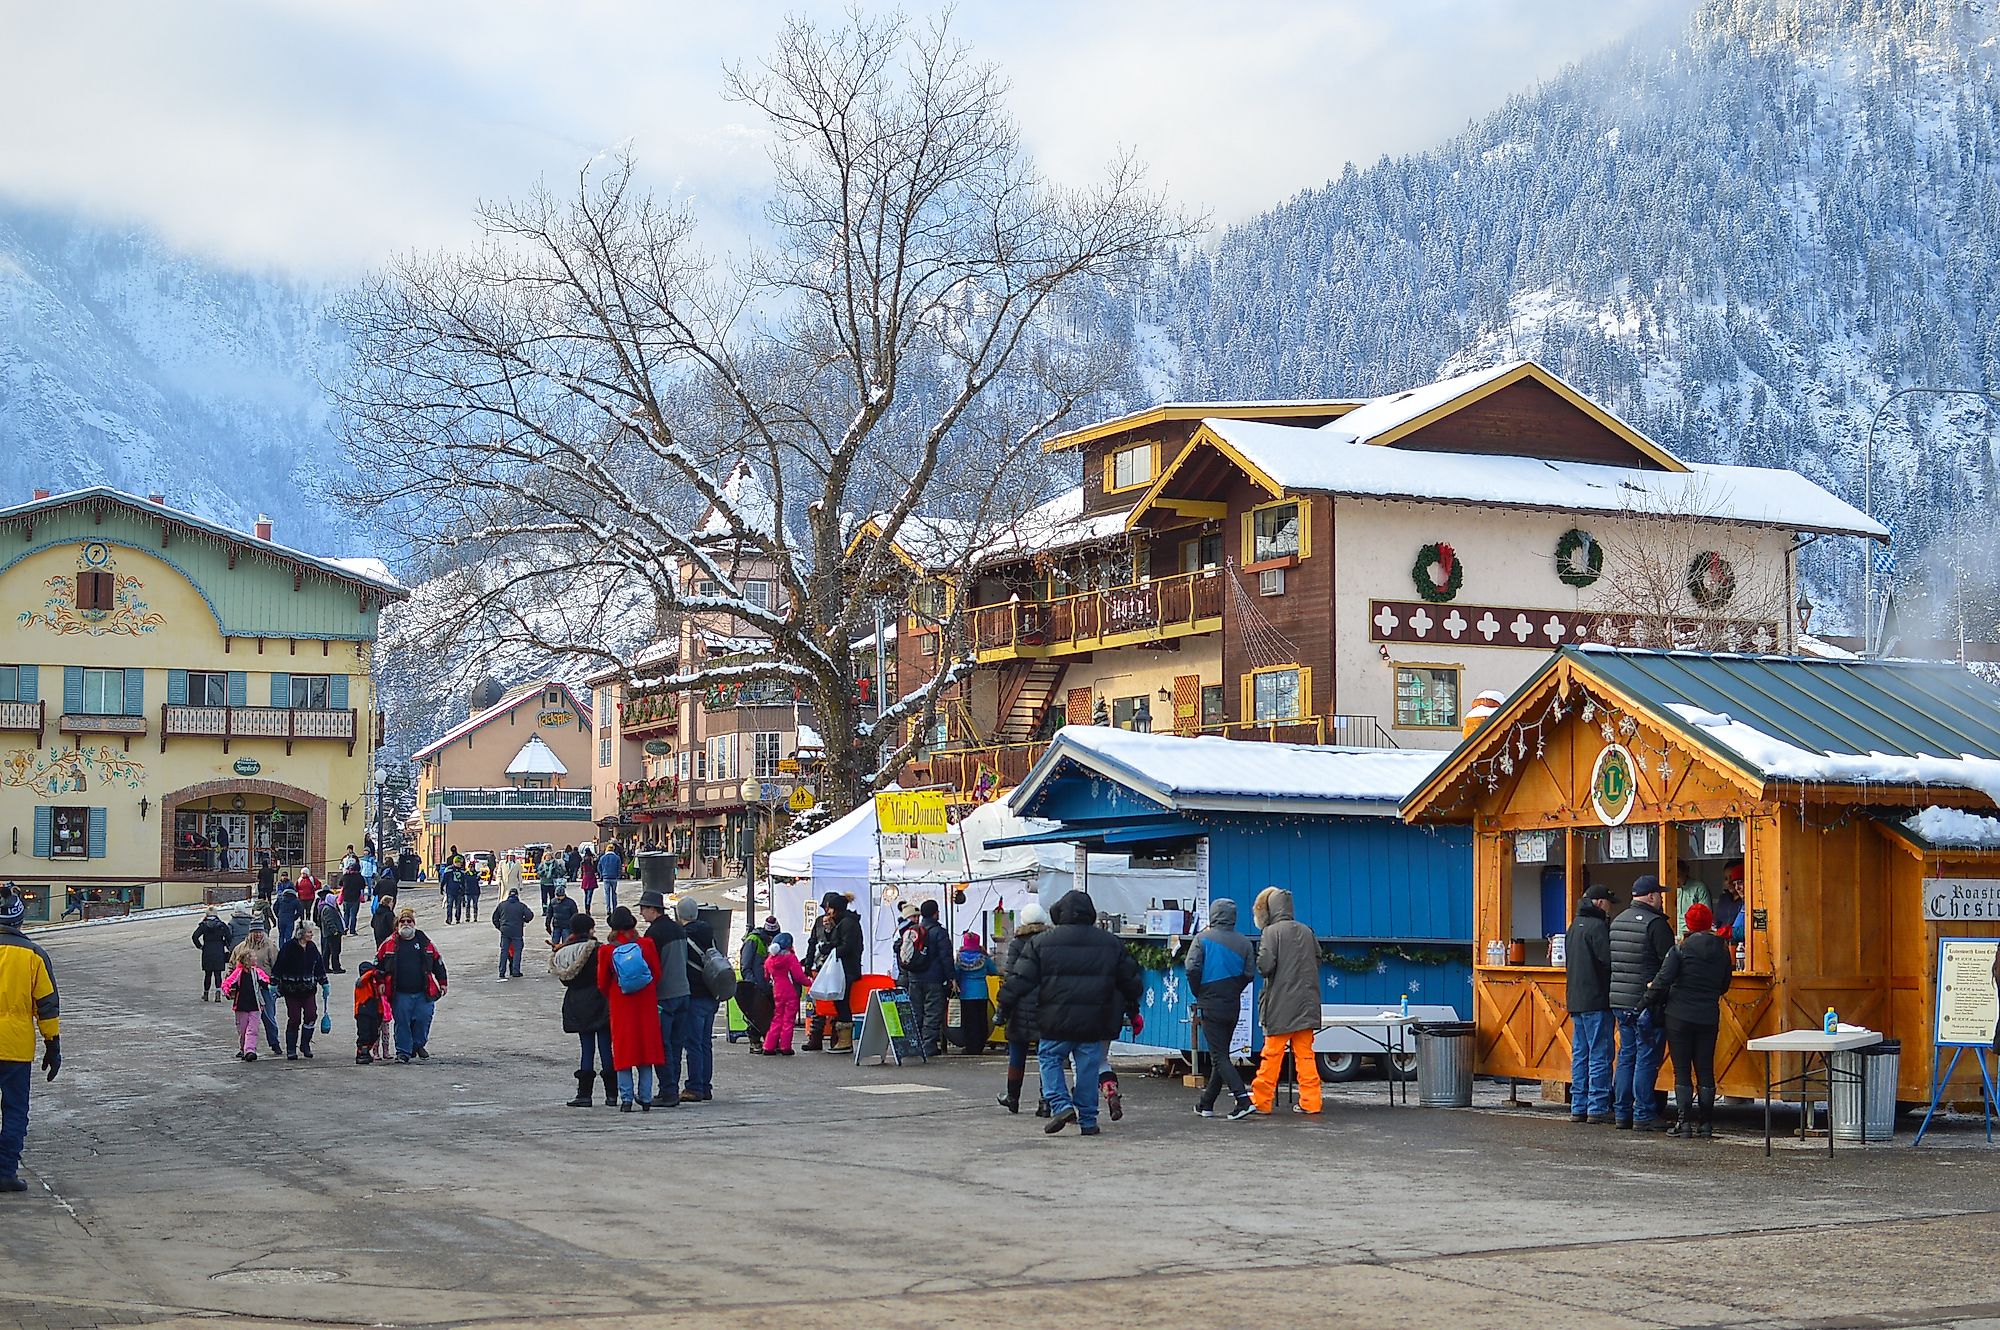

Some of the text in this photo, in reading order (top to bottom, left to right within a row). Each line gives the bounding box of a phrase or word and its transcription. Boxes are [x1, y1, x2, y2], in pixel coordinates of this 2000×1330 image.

[1112, 592, 1152, 619] Hotel
[1607, 770, 1620, 796] L
[890, 800, 944, 827] Mini-Donuts
